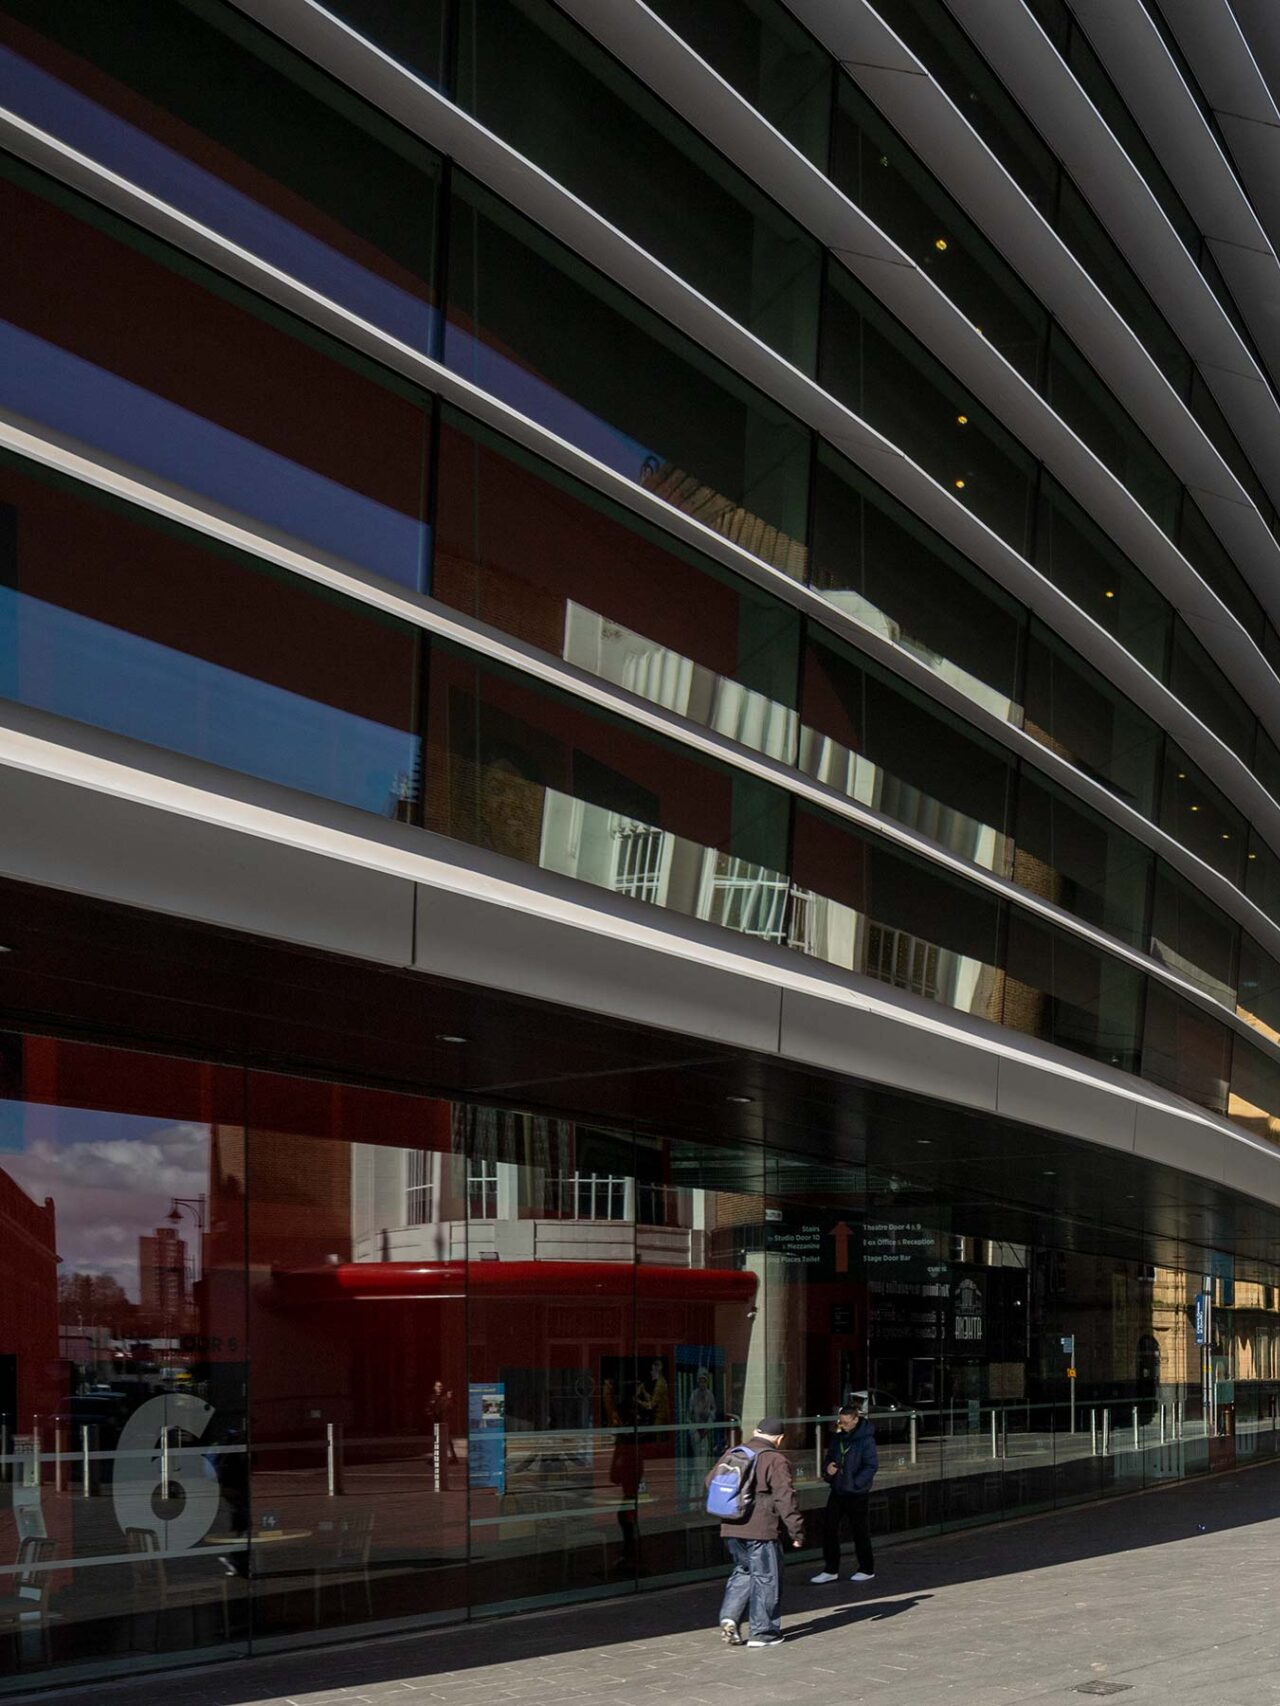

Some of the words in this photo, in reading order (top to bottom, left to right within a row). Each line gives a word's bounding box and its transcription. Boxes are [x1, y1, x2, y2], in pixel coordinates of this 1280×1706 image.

[774, 1234, 795, 1242] Studio
[877, 1238, 897, 1246] Office
[902, 1237, 935, 1246] Reception
[801, 1255, 821, 1263] Toilet
[863, 1255, 882, 1263] Stage
[112, 1392, 221, 1551] 6
